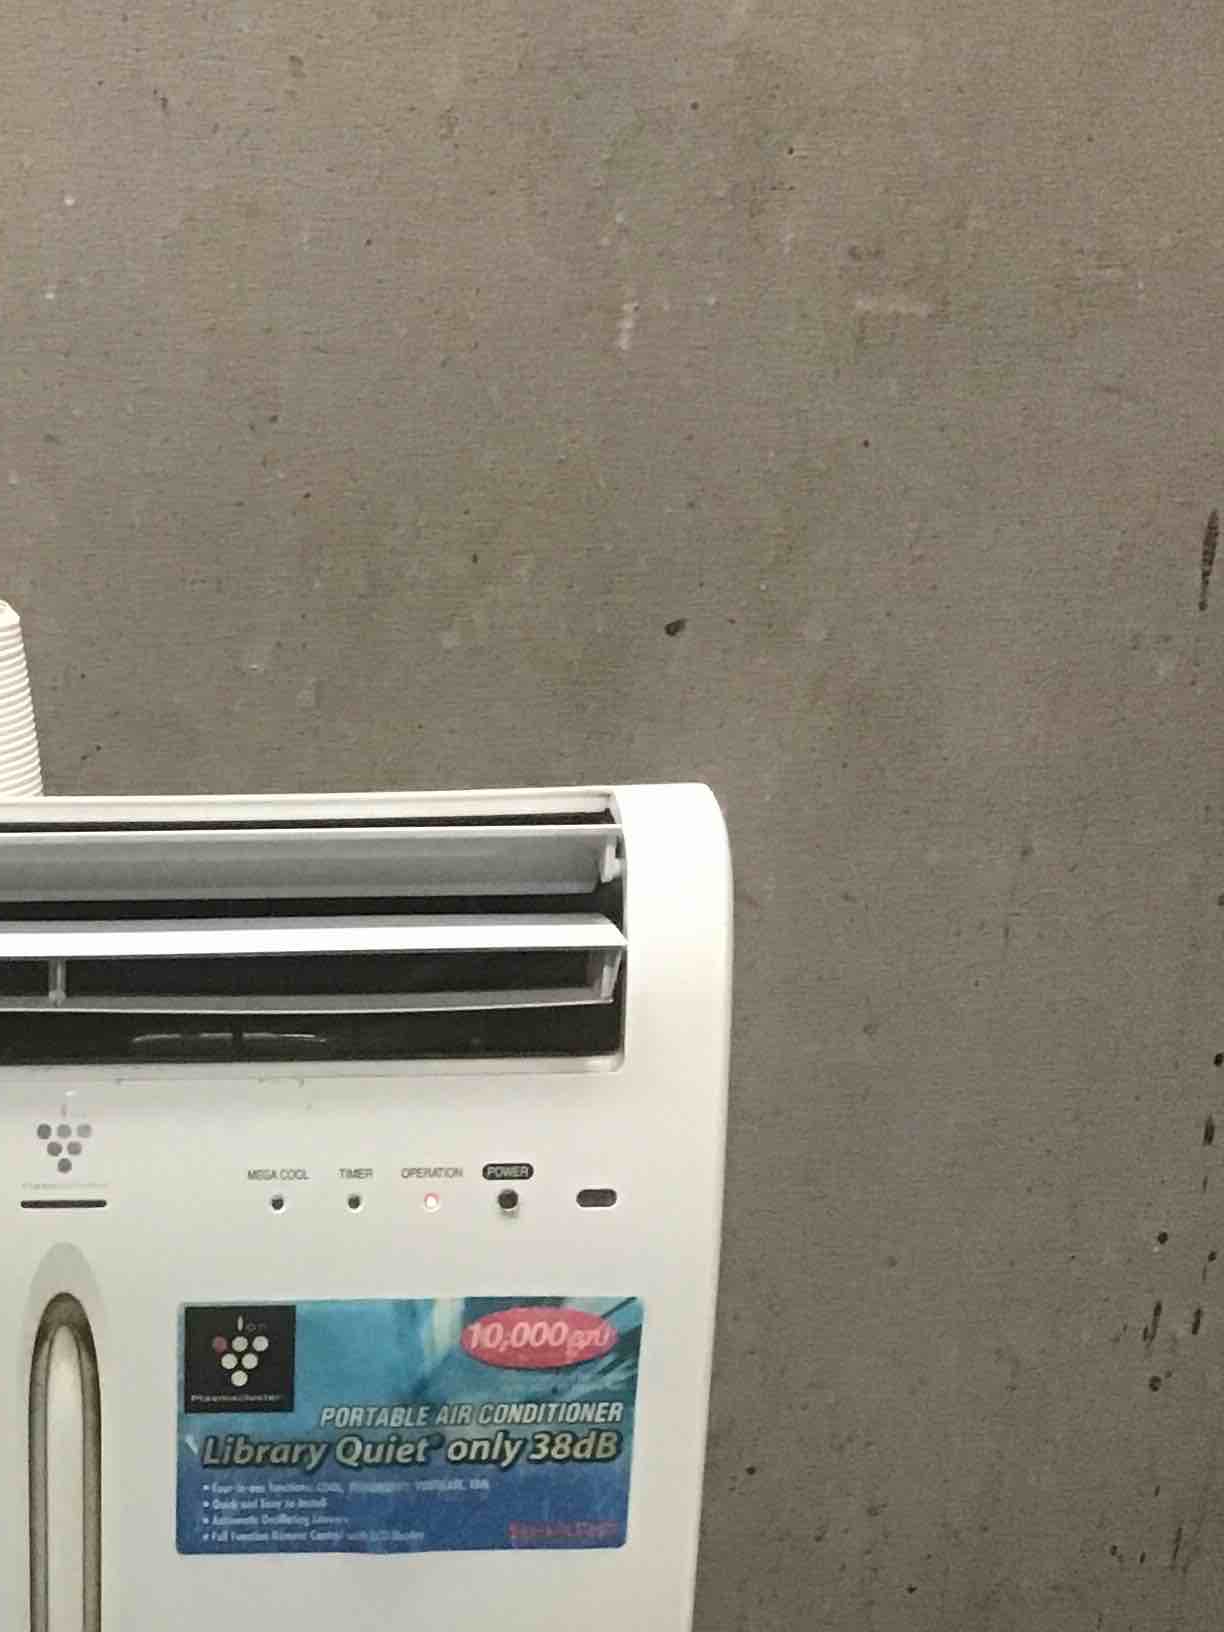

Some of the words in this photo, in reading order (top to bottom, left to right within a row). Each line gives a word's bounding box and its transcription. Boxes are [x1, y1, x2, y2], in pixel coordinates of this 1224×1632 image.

[247, 1168, 276, 1180] MEGA
[279, 1168, 311, 1180] COOL
[338, 1167, 374, 1180] TIMER
[400, 1167, 463, 1179] OPERATION
[486, 1165, 529, 1179] POWER
[468, 1320, 569, 1353] 10,000
[319, 1405, 431, 1429] PORTABLE
[435, 1404, 474, 1426] AIR
[478, 1401, 624, 1425] CONDITIONER
[201, 1435, 330, 1472] Library
[447, 1431, 524, 1468] only
[528, 1430, 619, 1461] 38dB
